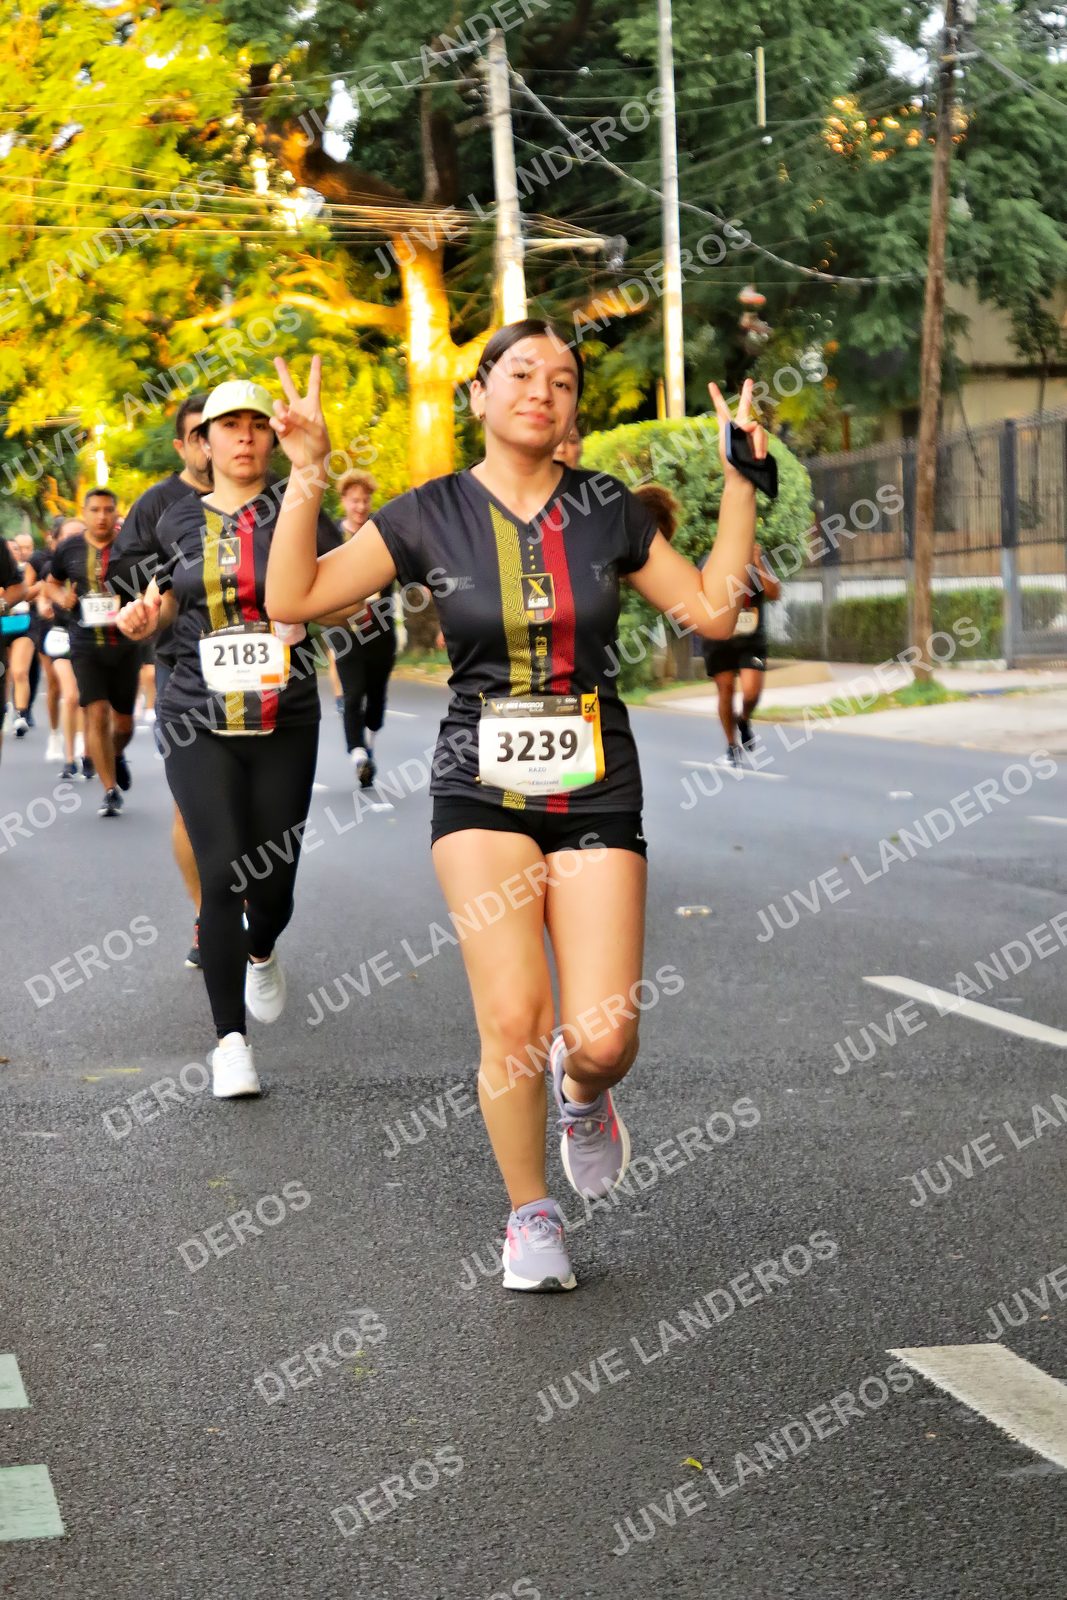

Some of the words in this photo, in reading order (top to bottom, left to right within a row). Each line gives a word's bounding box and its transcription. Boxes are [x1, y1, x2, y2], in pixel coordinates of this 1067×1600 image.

[213, 642, 270, 666] 2183
[585, 701, 597, 713] 5K
[496, 729, 578, 762] 3239
